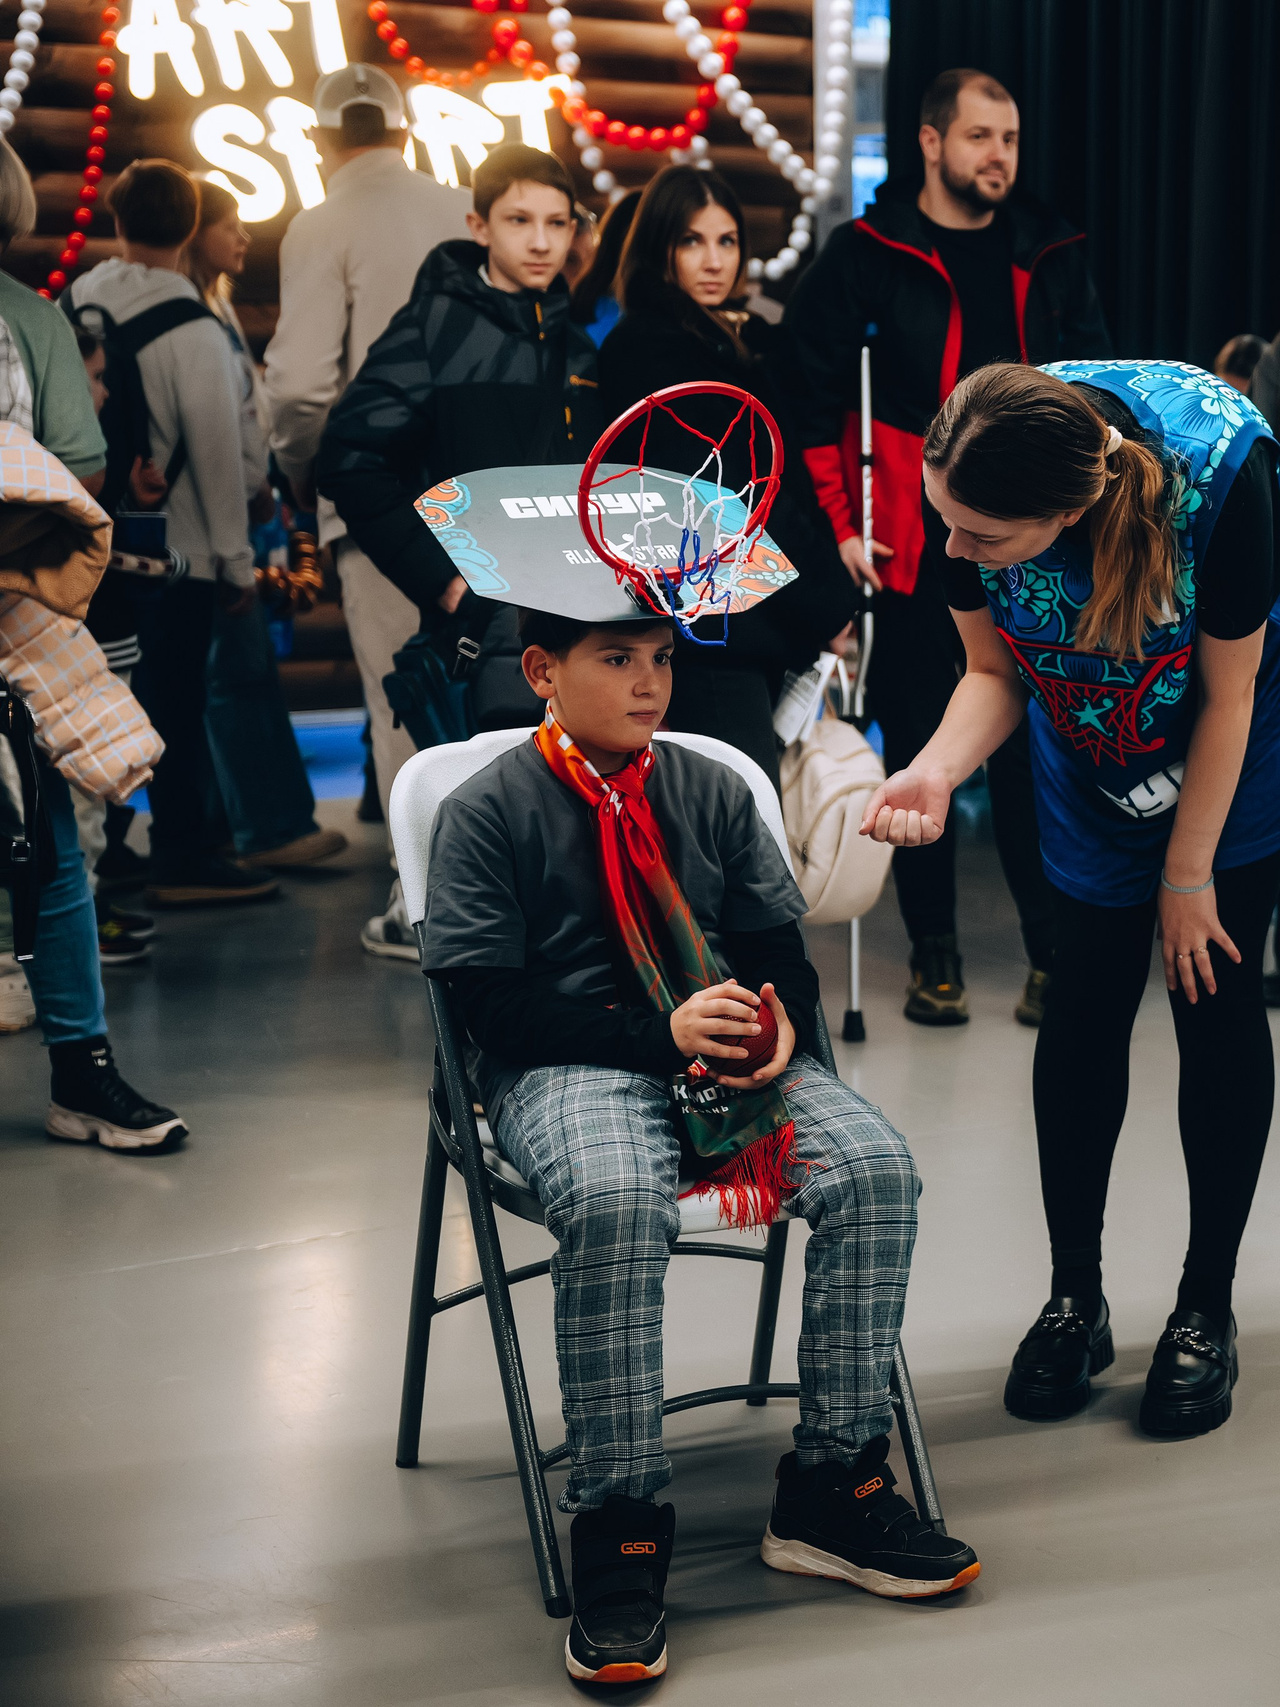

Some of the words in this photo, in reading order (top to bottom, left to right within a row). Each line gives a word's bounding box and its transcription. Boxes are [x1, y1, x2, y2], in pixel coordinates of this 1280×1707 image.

[115, 0, 348, 100] ART
[500, 491, 667, 519] СИБУР
[854, 1476, 884, 1499] GSD
[620, 1541, 657, 1555] GSD
